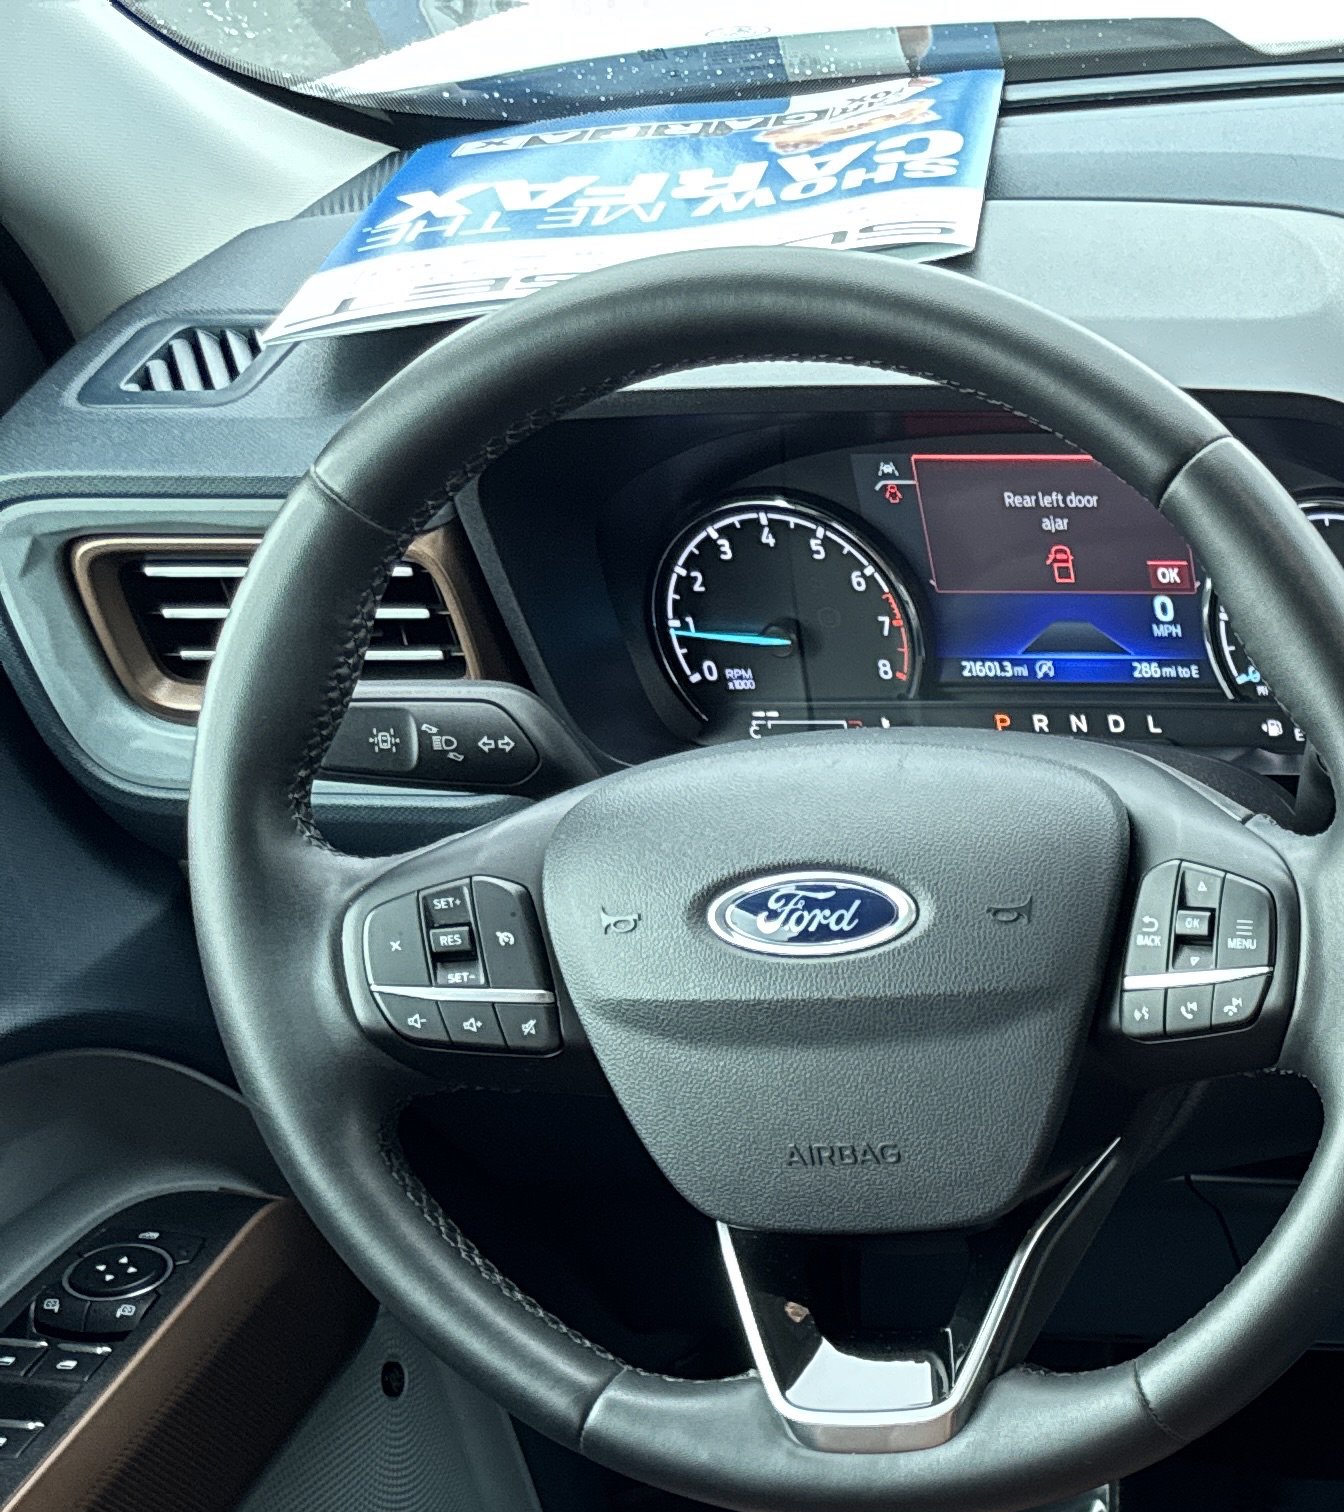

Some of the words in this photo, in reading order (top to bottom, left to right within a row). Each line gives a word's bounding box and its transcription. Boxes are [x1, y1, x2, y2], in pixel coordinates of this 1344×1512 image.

[371, 129, 965, 229] CARFAX
[691, 158, 960, 217] SHOW
[536, 201, 668, 230] ME
[357, 210, 511, 253] THE
[1003, 491, 1036, 508] Rear
[1039, 491, 1065, 508] left
[1067, 491, 1098, 508] door
[1041, 515, 1069, 533] ajar
[761, 527, 776, 548] 4
[716, 539, 733, 560] 3
[810, 539, 826, 560] 5
[690, 571, 706, 592] 2
[851, 570, 866, 592] 6
[1156, 567, 1181, 584] OK
[1152, 595, 1175, 622] 0
[877, 616, 890, 636] 7
[1152, 623, 1182, 638] MPH
[702, 660, 718, 681] 0
[725, 668, 753, 680] RPM
[877, 659, 893, 680] 8
[1014, 664, 1029, 677] mi
[1132, 662, 1161, 678] 286
[1162, 664, 1177, 678] mi
[1178, 665, 1190, 678] to
[993, 713, 1012, 732] P
[1032, 714, 1049, 733] R
[1069, 714, 1088, 733] N
[1107, 714, 1125, 733] D
[1147, 715, 1162, 733] L
[757, 887, 861, 934] Ford
[1185, 918, 1200, 929] OK
[440, 934, 462, 946] RES
[1136, 934, 1161, 946] BACK
[1227, 938, 1257, 949] MENU
[788, 1142, 901, 1166] AIRBAG
